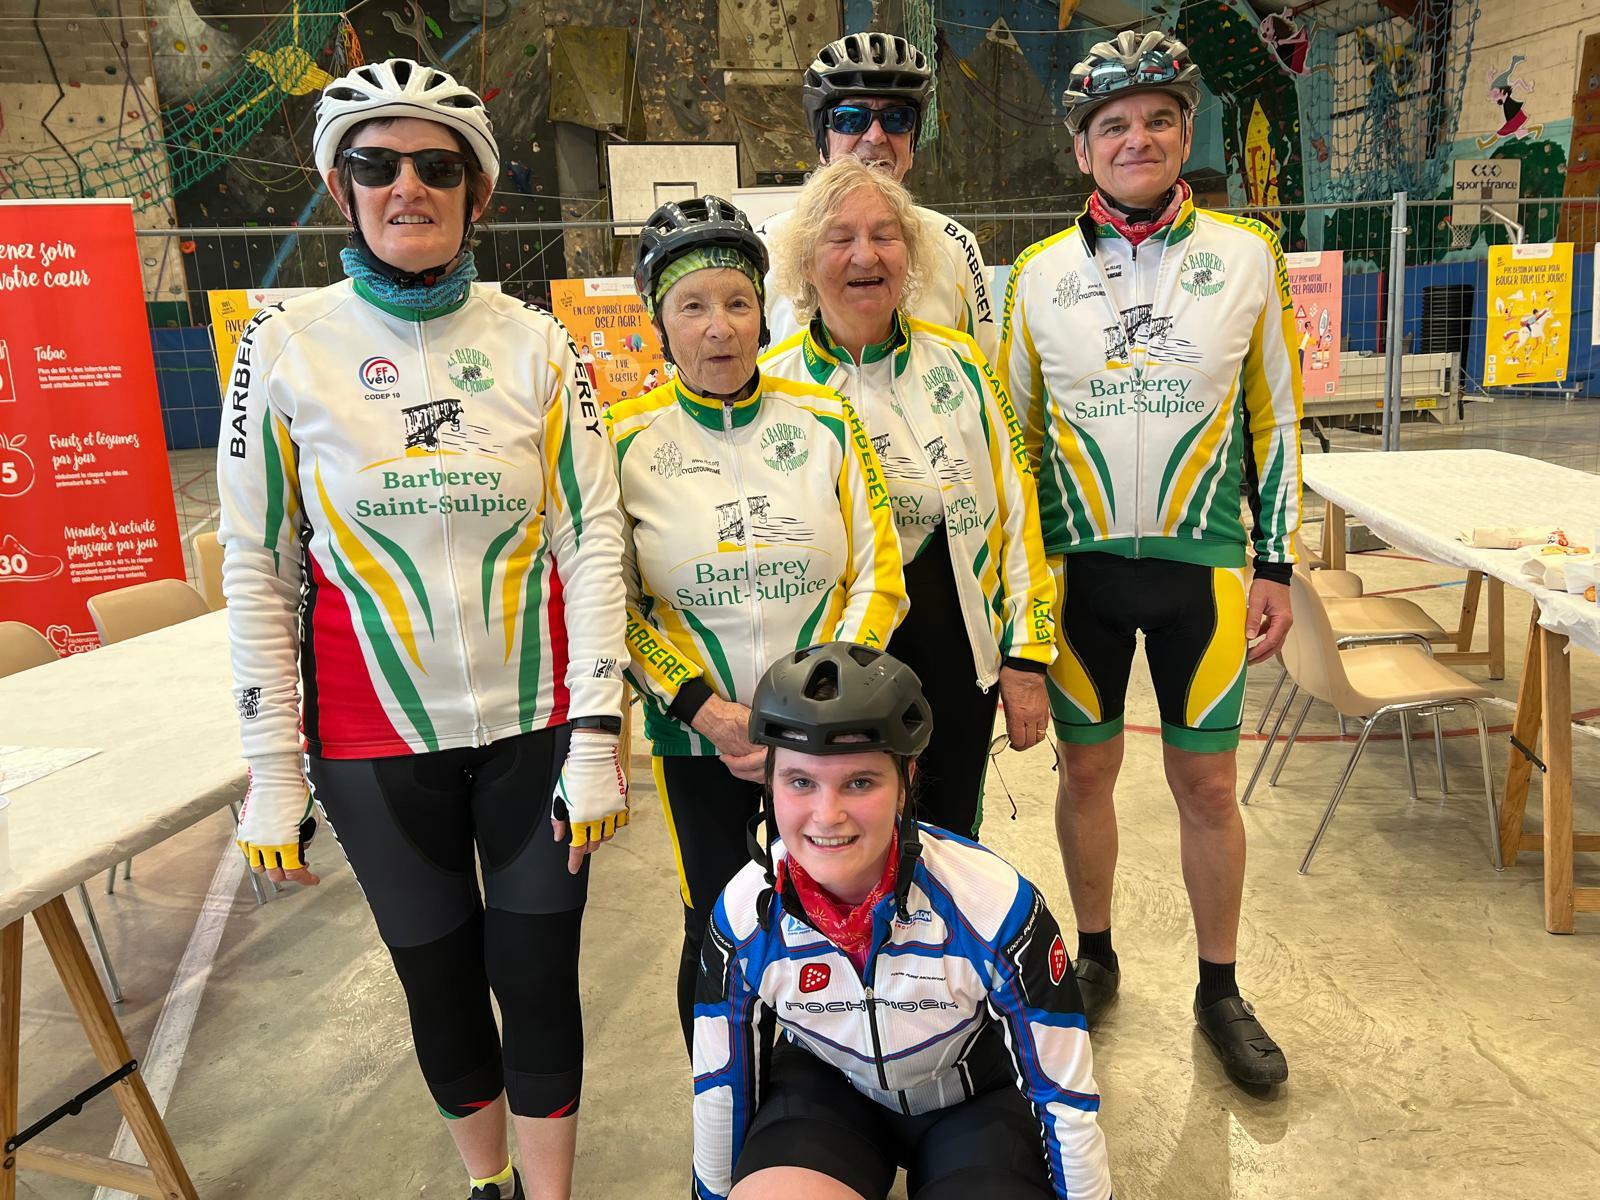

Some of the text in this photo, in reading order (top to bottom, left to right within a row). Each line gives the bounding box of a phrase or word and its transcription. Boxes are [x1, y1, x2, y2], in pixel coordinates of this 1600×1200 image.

[1456, 178, 1517, 190] sport france
[0, 240, 76, 267] enez soin
[0, 264, 91, 291] votre cœur
[943, 222, 994, 324] BARBEREY
[1303, 282, 1328, 294] PARTOUT
[595, 316, 615, 328] OSEZ
[618, 315, 637, 327] AGIR
[33, 345, 67, 362] Tabac
[229, 301, 286, 459] BARBEREY
[367, 373, 396, 385] vélo
[375, 366, 388, 376] FF
[614, 372, 638, 382] GESTES
[364, 393, 391, 401] CODEP
[1089, 375, 1192, 398] Barberey
[1075, 394, 1205, 419] Saint-Sulpice
[982, 362, 1032, 475] BARBEREY
[49, 430, 139, 452] Fruits et légumes
[766, 423, 807, 444] BARBEREY
[52, 452, 96, 471] par jour
[2, 462, 18, 484] 5
[382, 468, 503, 491] Barberey
[356, 494, 527, 518] Saint-Sulpice
[64, 518, 156, 540] Minutes d'activité
[67, 538, 158, 560] physique par jour
[0, 554, 28, 575] 30
[695, 559, 811, 585] Barberey
[676, 577, 827, 607] Saint-Sulpice
